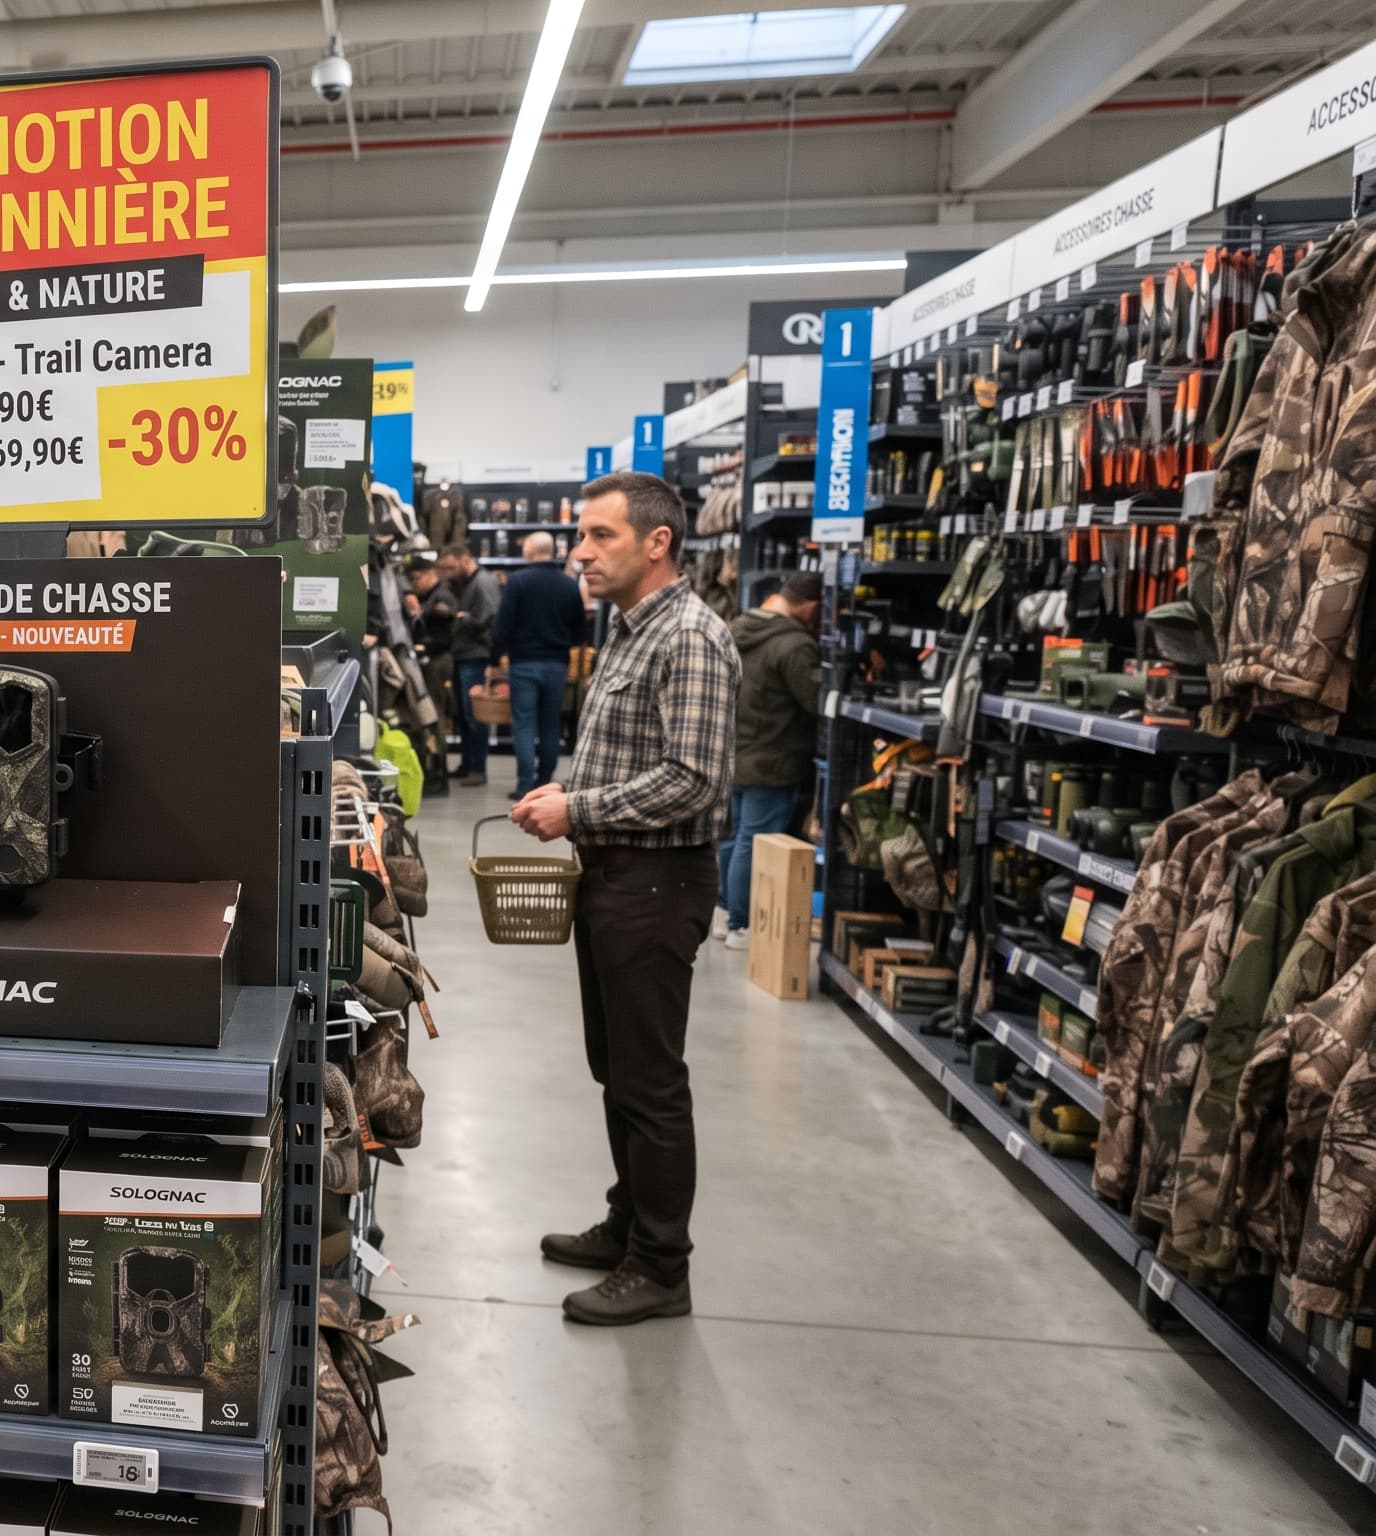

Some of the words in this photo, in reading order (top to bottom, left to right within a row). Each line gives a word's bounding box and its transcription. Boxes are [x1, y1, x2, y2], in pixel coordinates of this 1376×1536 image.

[1054, 210, 1113, 256] ACCESSOIRES
[1112, 187, 1156, 228] CHASSE
[8, 280, 29, 311] &
[39, 269, 166, 309] NATURE
[839, 321, 852, 357] 1
[15, 339, 82, 376] Trail
[92, 339, 213, 373] Camera
[108, 404, 248, 467] -30%
[642, 421, 653, 445] 1
[594, 451, 604, 472] 1
[43, 581, 172, 613] CHASSE
[12, 622, 124, 646] NOUVEAUTÉ
[119, 1152, 208, 1162] SOLOGNAC
[110, 1186, 207, 1204] SOLOGNAC
[71, 1353, 91, 1366] 30
[114, 1509, 200, 1525] SOLOGNAC
